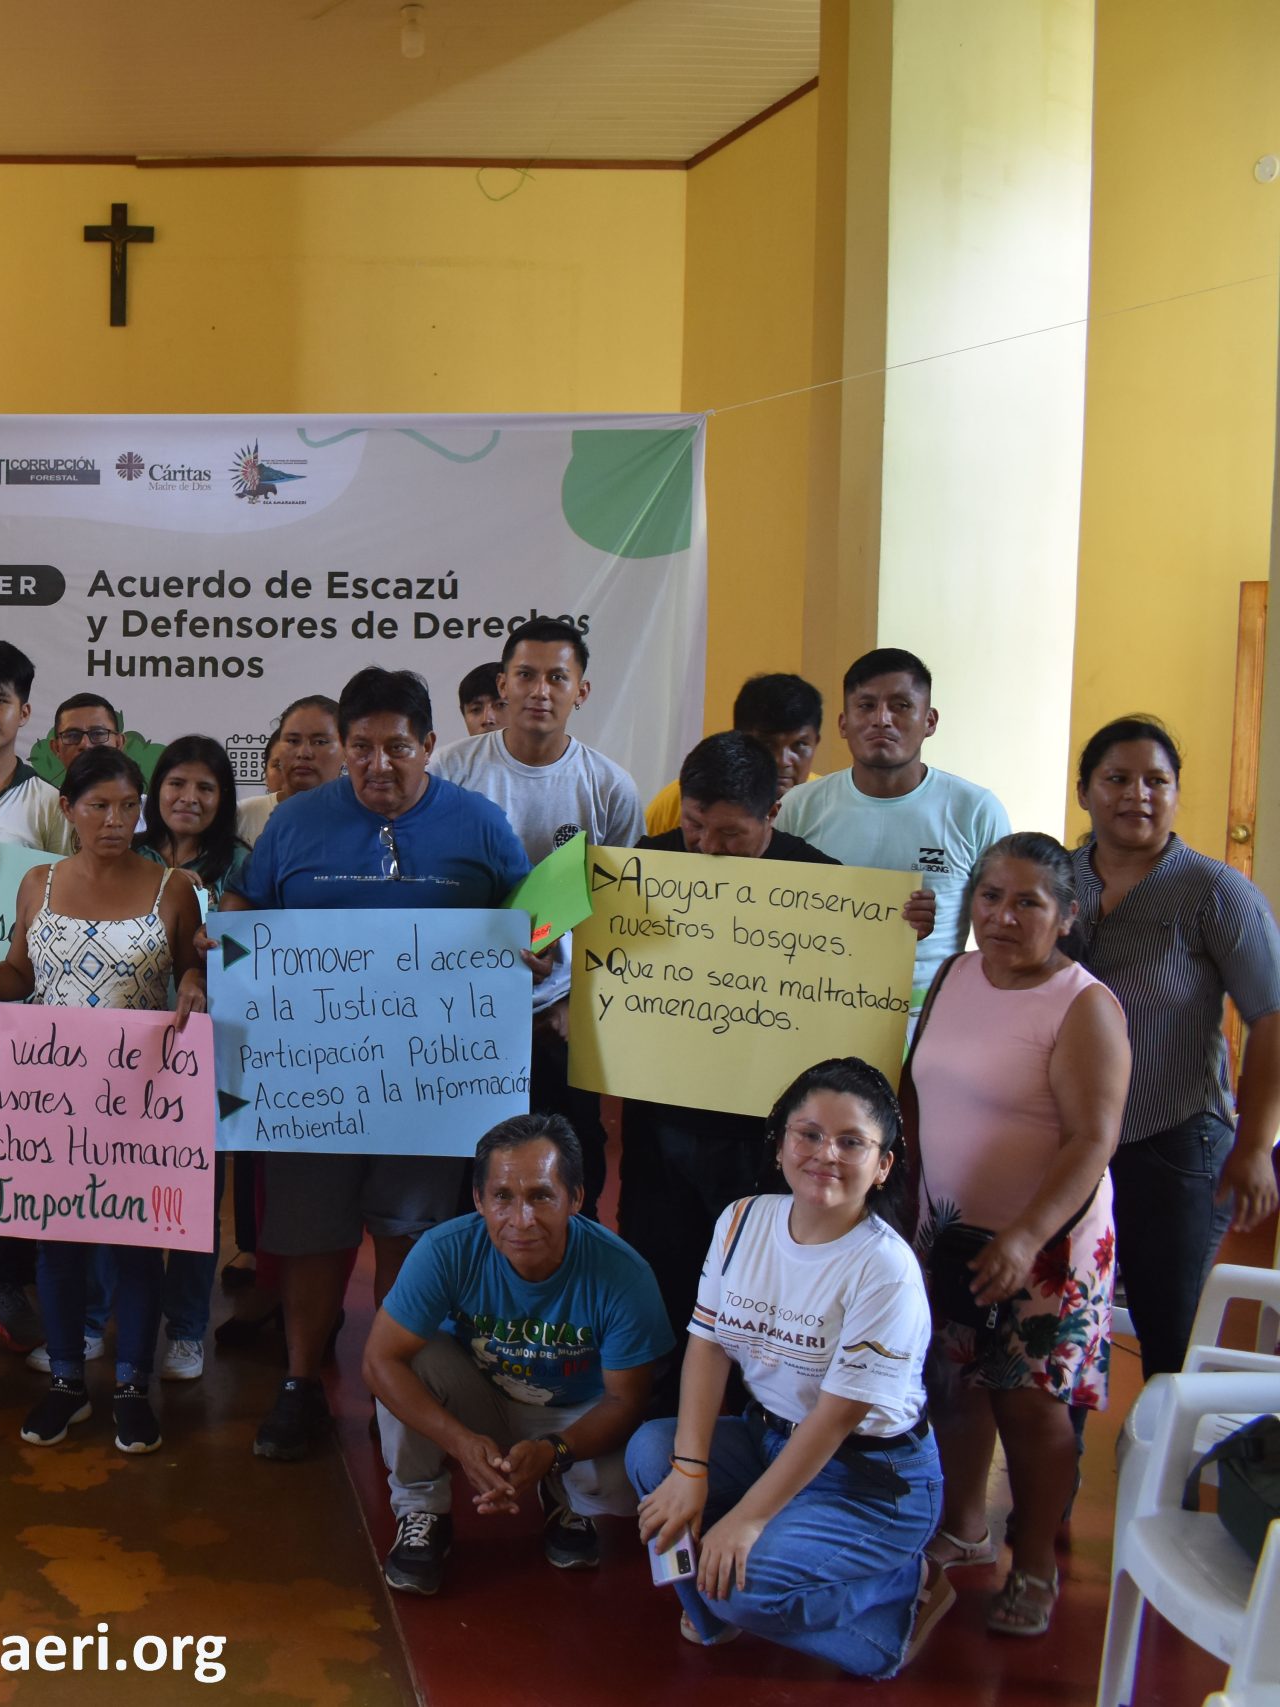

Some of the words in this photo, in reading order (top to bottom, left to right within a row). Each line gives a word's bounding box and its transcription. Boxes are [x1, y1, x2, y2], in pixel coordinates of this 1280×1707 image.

[148, 482, 176, 491] Madre
[178, 482, 189, 491] de
[192, 482, 212, 491] Dios
[149, 464, 212, 482] Cáritas
[87, 570, 251, 598] Acuerdo
[265, 570, 312, 599] de
[327, 570, 459, 600] Escazú
[87, 615, 108, 642] y
[123, 609, 337, 639] Defensores
[351, 611, 398, 640] de
[87, 650, 264, 678] Humanos
[618, 857, 729, 914] Apoyar
[736, 885, 756, 904] a
[769, 886, 899, 922] conservar
[253, 923, 375, 980] Promover
[397, 923, 419, 972] el
[431, 948, 515, 972] acceso
[610, 914, 714, 940] nuestros
[733, 916, 853, 964] bosques.
[606, 947, 654, 985] Que
[664, 964, 693, 982] no
[707, 970, 768, 993] sean
[779, 977, 910, 1014] maltratados
[245, 1000, 260, 1021] a
[272, 985, 294, 1022] la
[312, 985, 418, 1024] Justicia
[440, 996, 454, 1023] y
[469, 982, 496, 1019] la
[599, 993, 614, 1022] y
[625, 993, 799, 1034] amenazados.
[11, 1022, 87, 1067] vidas
[108, 1027, 142, 1070] de
[157, 1025, 199, 1077] los
[240, 1036, 385, 1074] Participación
[95, 1078, 127, 1117] de
[140, 1080, 184, 1122] los
[255, 1082, 344, 1110] Acceso
[356, 1083, 370, 1104] a
[381, 1070, 402, 1103] la
[415, 1066, 531, 1106] Información
[67, 1125, 209, 1170] Humanos
[726, 1290, 776, 1316] TODOS
[777, 1307, 825, 1328] SOMOS
[718, 1312, 826, 1349] AMARAKAERI
[539, 1350, 558, 1360] DEL
